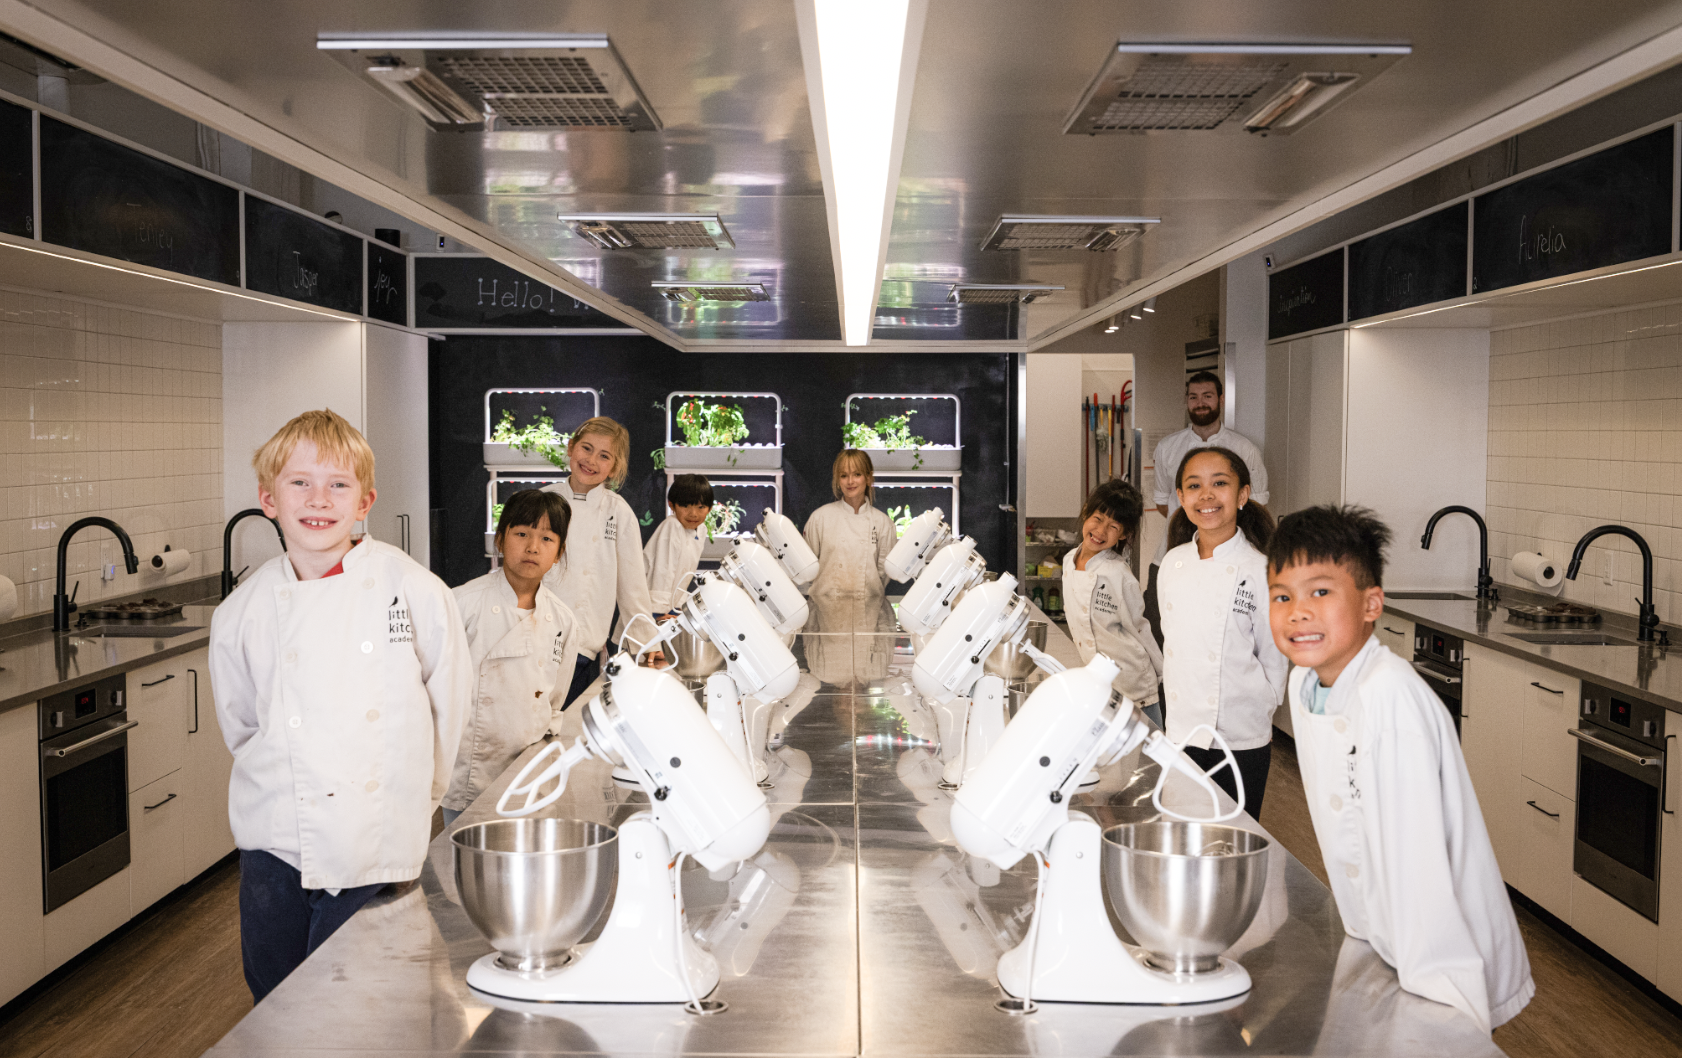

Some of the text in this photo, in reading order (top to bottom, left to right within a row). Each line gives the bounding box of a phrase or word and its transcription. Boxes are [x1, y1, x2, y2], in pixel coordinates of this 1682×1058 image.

[1518, 214, 1567, 264] Aurelia
[292, 250, 319, 297] Jasper
[477, 277, 555, 313] Hello!
[1096, 590, 1112, 602] little
[1236, 587, 1254, 600] little
[1095, 598, 1118, 611] kitchen
[388, 608, 409, 621] littl
[389, 622, 413, 634] kitc
[389, 635, 413, 643] acade
